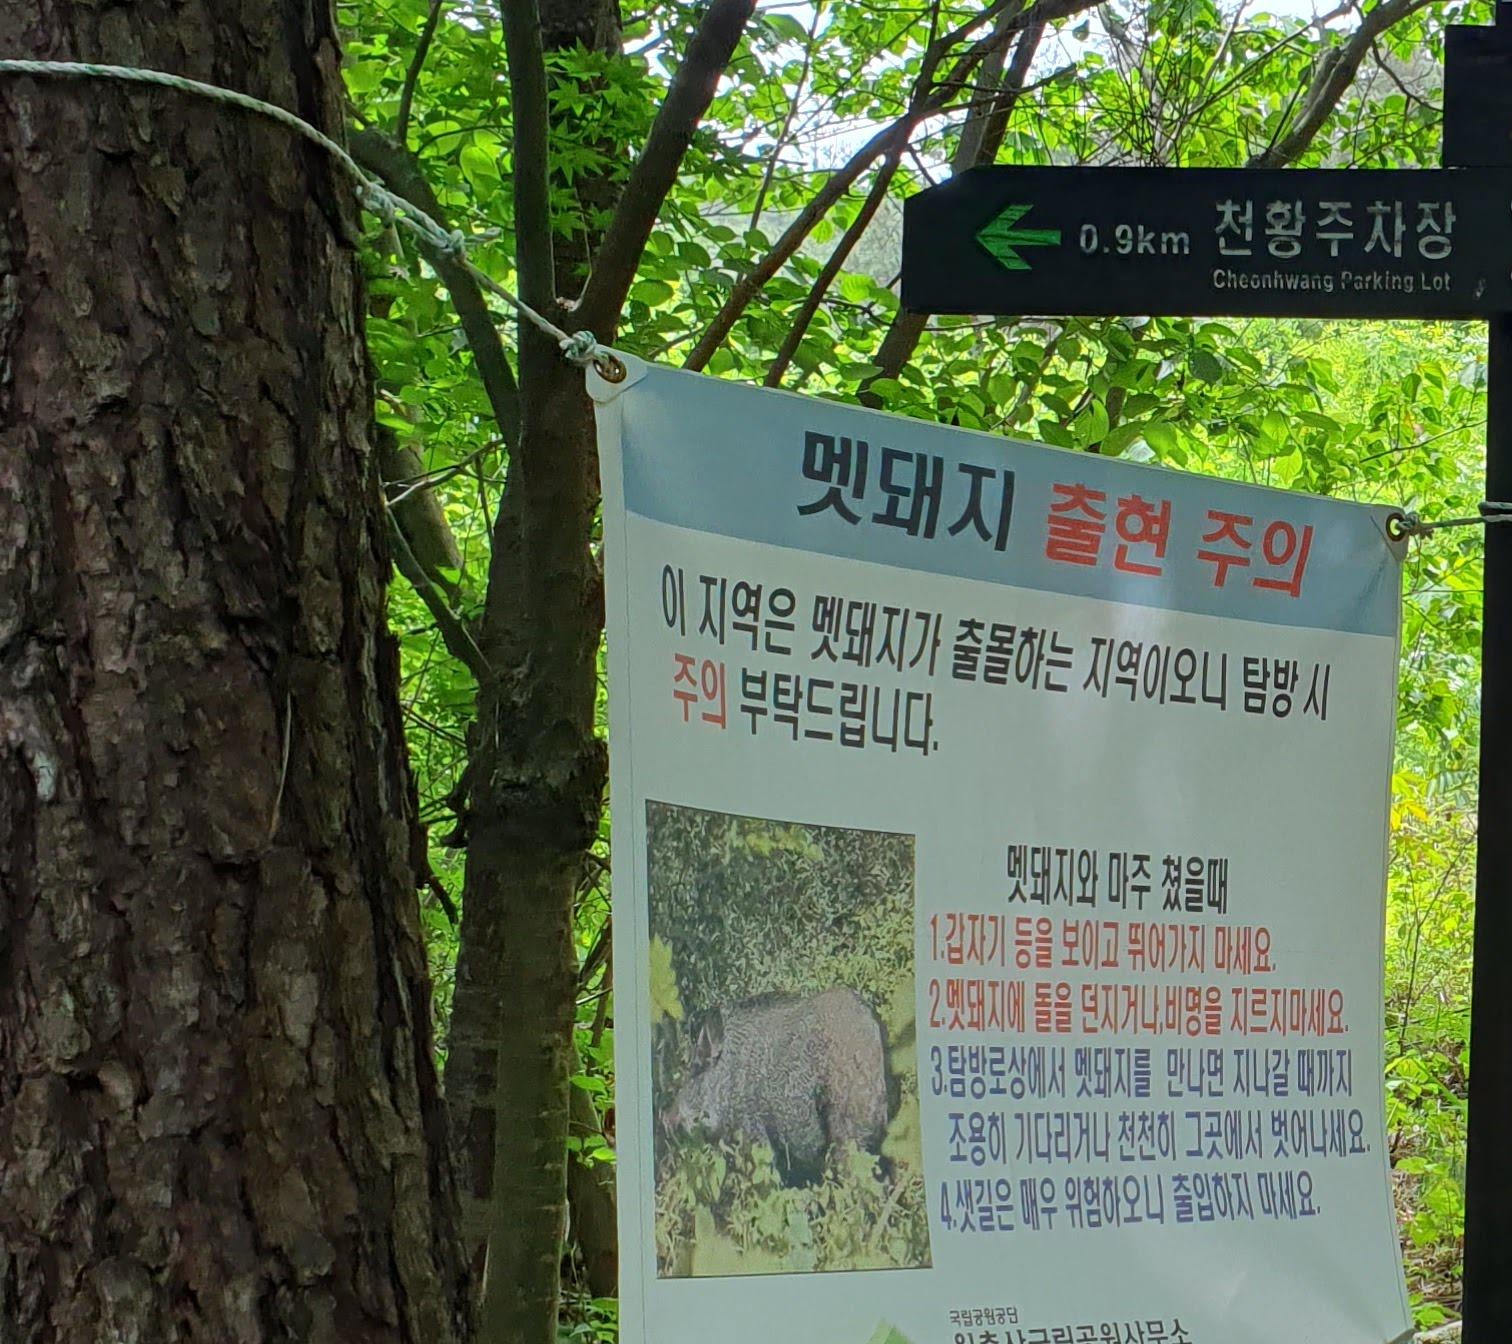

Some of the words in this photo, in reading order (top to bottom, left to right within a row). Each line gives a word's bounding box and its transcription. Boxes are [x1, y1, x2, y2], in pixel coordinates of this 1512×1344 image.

[1079, 224, 1190, 255] 0.9km
[1215, 199, 1456, 259] 천황주차장
[1213, 269, 1334, 292] Cheonhwang
[1340, 270, 1414, 292] Parking
[1422, 270, 1450, 292] Lot
[797, 431, 1014, 551] 멧돼지
[1045, 484, 1171, 576] 출현
[1197, 510, 1313, 597] 주의
[662, 565, 685, 636] 이
[699, 575, 795, 655] 지역은
[811, 596, 942, 676] 멧돼지가
[952, 618, 1073, 692] 출몰하는
[1083, 637, 1227, 711] 지역이오니
[1244, 657, 1298, 718] 탐방
[1303, 664, 1330, 720] 시
[674, 653, 726, 729] 주의
[739, 665, 941, 754] 부탁드립니다.
[1008, 845, 1098, 907] 멧돼지와
[1109, 853, 1151, 910] 마주
[1162, 855, 1228, 914] 쳤을때
[931, 913, 1005, 967] 1.갑자기
[1015, 917, 1053, 969] 등을
[1062, 919, 1119, 970] 보이고
[1128, 923, 1205, 973] 뛰어가지
[1215, 926, 1275, 975] 마세요.
[930, 979, 1025, 1032] 2.멧돼지에
[1034, 982, 1072, 1032] 돌을
[1082, 984, 1222, 1036] 던지거나,비명을
[1231, 987, 1348, 1036] 지르지마세요.
[931, 1045, 1065, 1099] 3.탐방로상에서
[1075, 1047, 1151, 1098] 멧돼지를
[1168, 1048, 1223, 1097] 만나면
[1234, 1049, 1290, 1097] 지나갈
[1298, 1049, 1351, 1096] 때까지
[949, 1112, 1006, 1166] 조용히
[1014, 1112, 1110, 1164] 기다리거나
[1118, 1111, 1176, 1161] 천천히
[1185, 1110, 1262, 1160] 그곳에서
[1271, 1109, 1370, 1158] 벗어나세요.
[941, 1179, 1014, 1232] 4.샛길은
[1020, 1178, 1057, 1230] 매우
[1065, 1174, 1164, 1228] 위험하오니
[1172, 1172, 1254, 1222] 출입하지
[1257, 1171, 1320, 1219] 마세요.
[950, 1307, 1018, 1327] 국립공원공단
